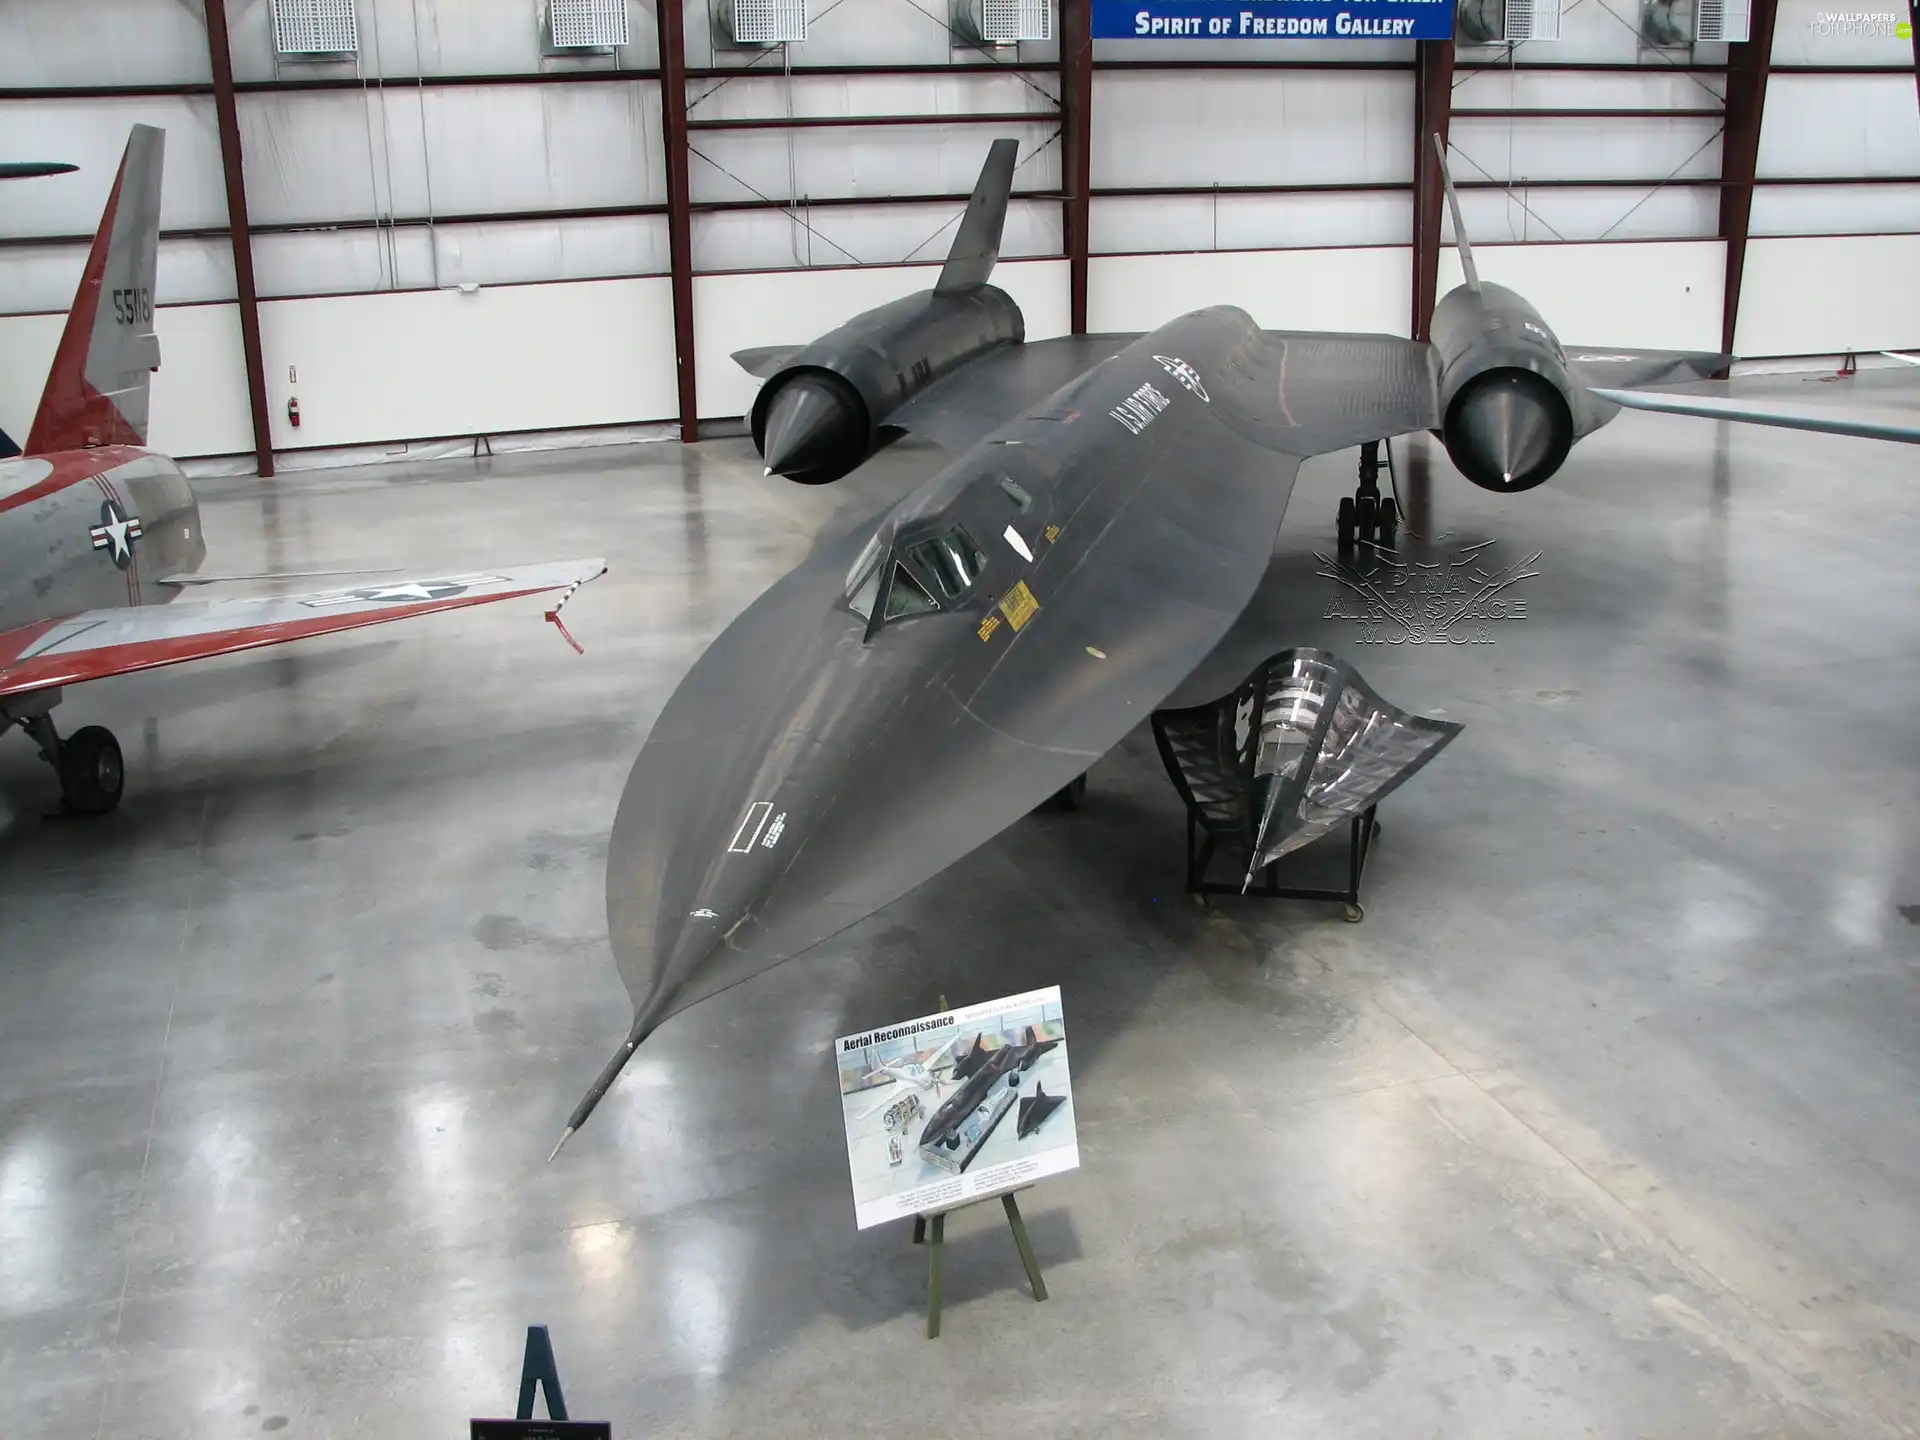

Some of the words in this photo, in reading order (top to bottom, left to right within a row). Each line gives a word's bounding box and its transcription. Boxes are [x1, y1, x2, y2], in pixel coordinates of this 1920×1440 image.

[1135, 11, 1202, 35] SPIRIT
[1208, 17, 1232, 35] OF
[1239, 11, 1327, 35] FREEDOM
[1335, 12, 1415, 35] GALLERY
[843, 1032, 872, 1052] Aerial
[874, 1015, 955, 1044] Reconnaissance
